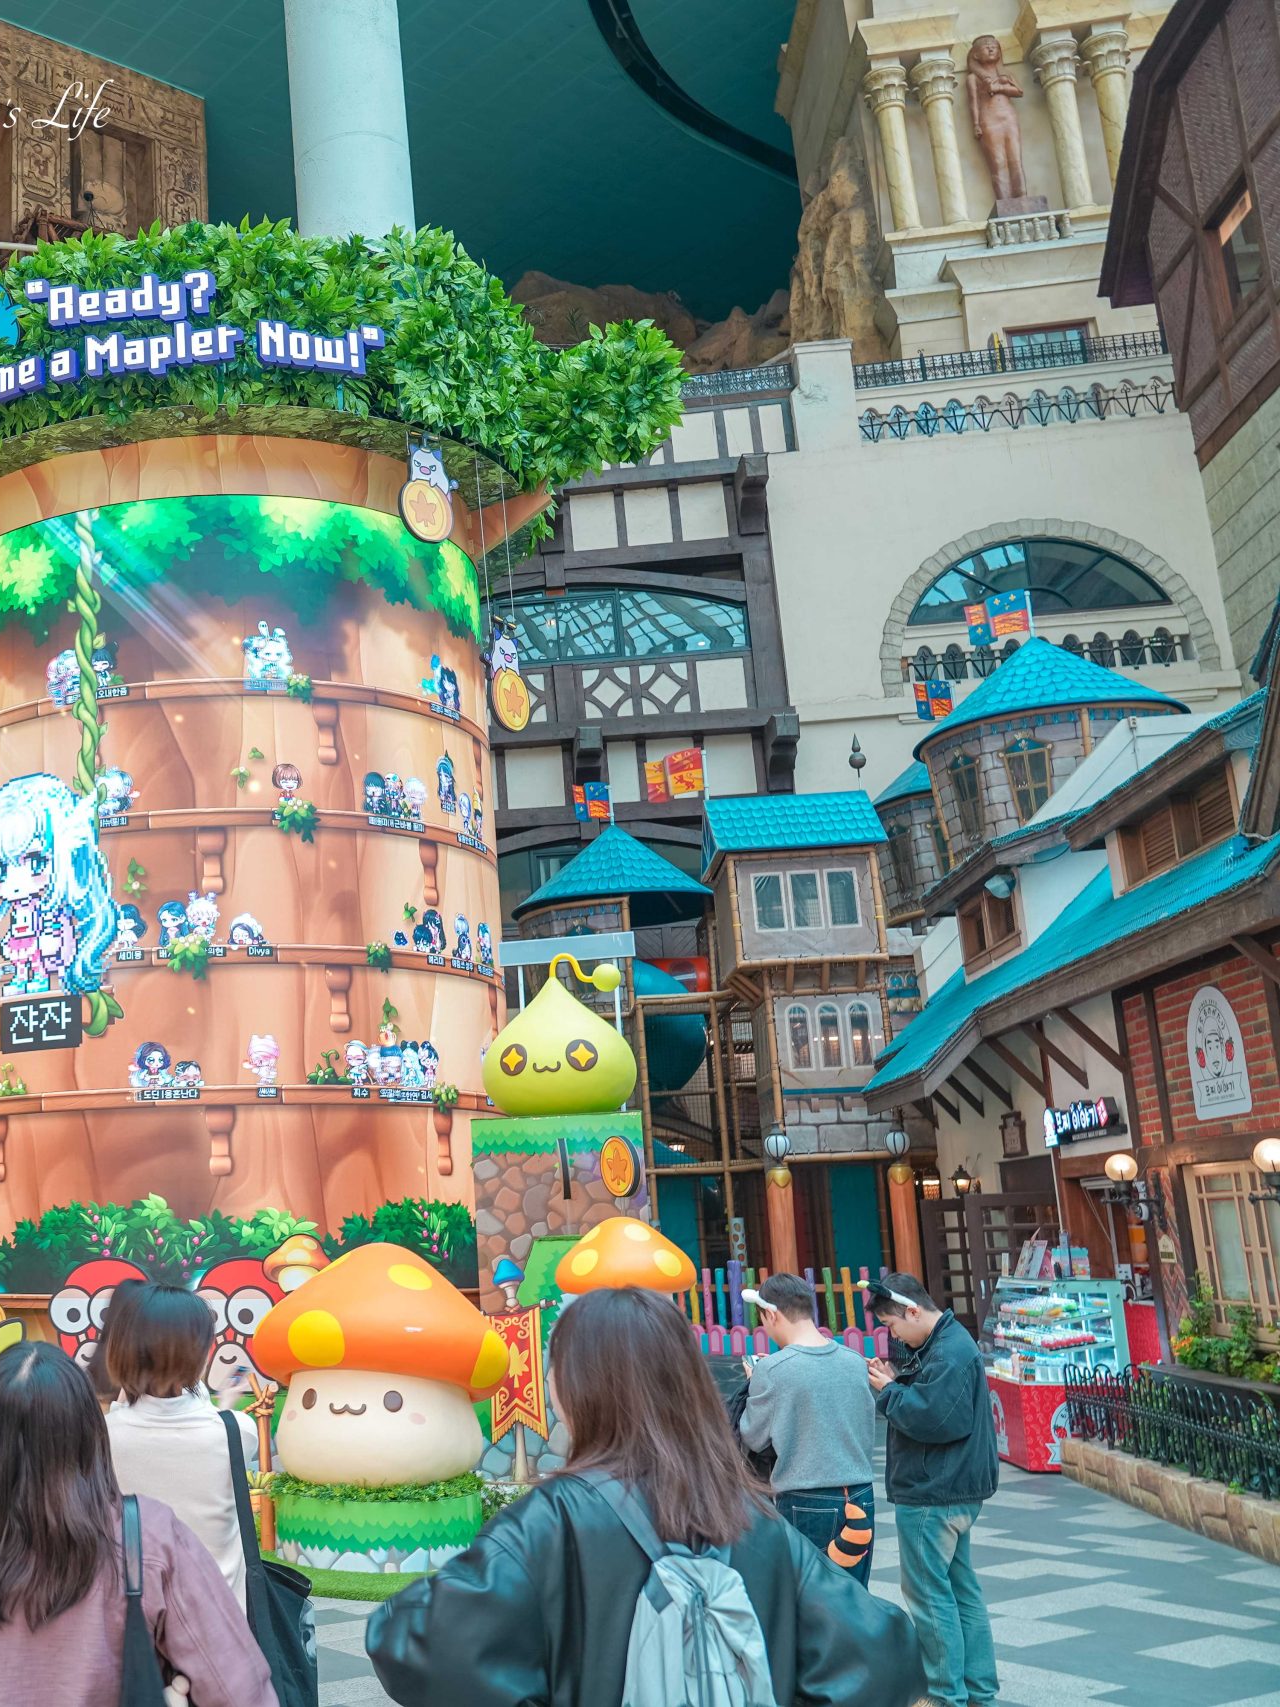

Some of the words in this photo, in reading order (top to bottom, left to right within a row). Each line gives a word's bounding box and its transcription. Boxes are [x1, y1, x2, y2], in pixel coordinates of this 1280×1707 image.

[50, 349, 71, 378] a
[85, 321, 238, 371] Mapler
[248, 946, 271, 957] Divya
